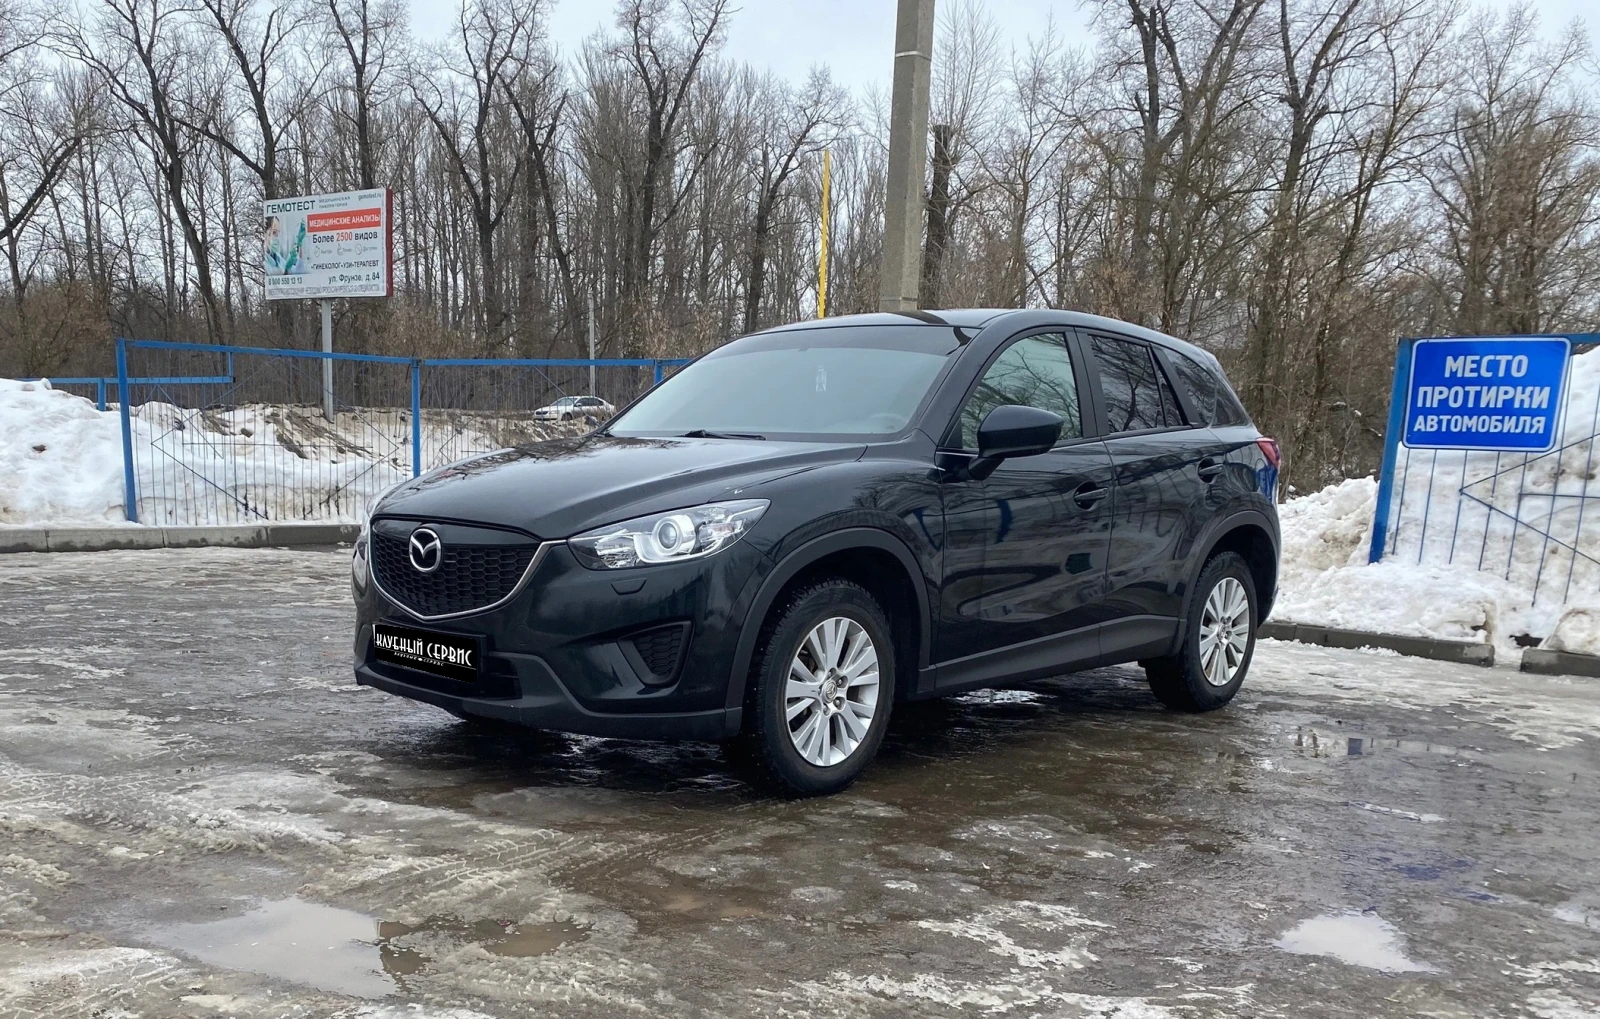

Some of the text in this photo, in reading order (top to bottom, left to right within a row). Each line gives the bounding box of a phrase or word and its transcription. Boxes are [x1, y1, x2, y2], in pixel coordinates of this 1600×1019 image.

[357, 192, 382, 201] gemotest.ru
[267, 201, 315, 213] ГЕМОТЕСТ
[309, 213, 381, 228] МЕДИЦИНСКИЕ АНАЛИЗЫ
[312, 231, 378, 244] Более 2500 видов
[1444, 355, 1529, 378] МЕСТО
[1416, 386, 1551, 409] ПРОТИРКИ
[1413, 415, 1546, 434] АВТОМОБИЛЯ
